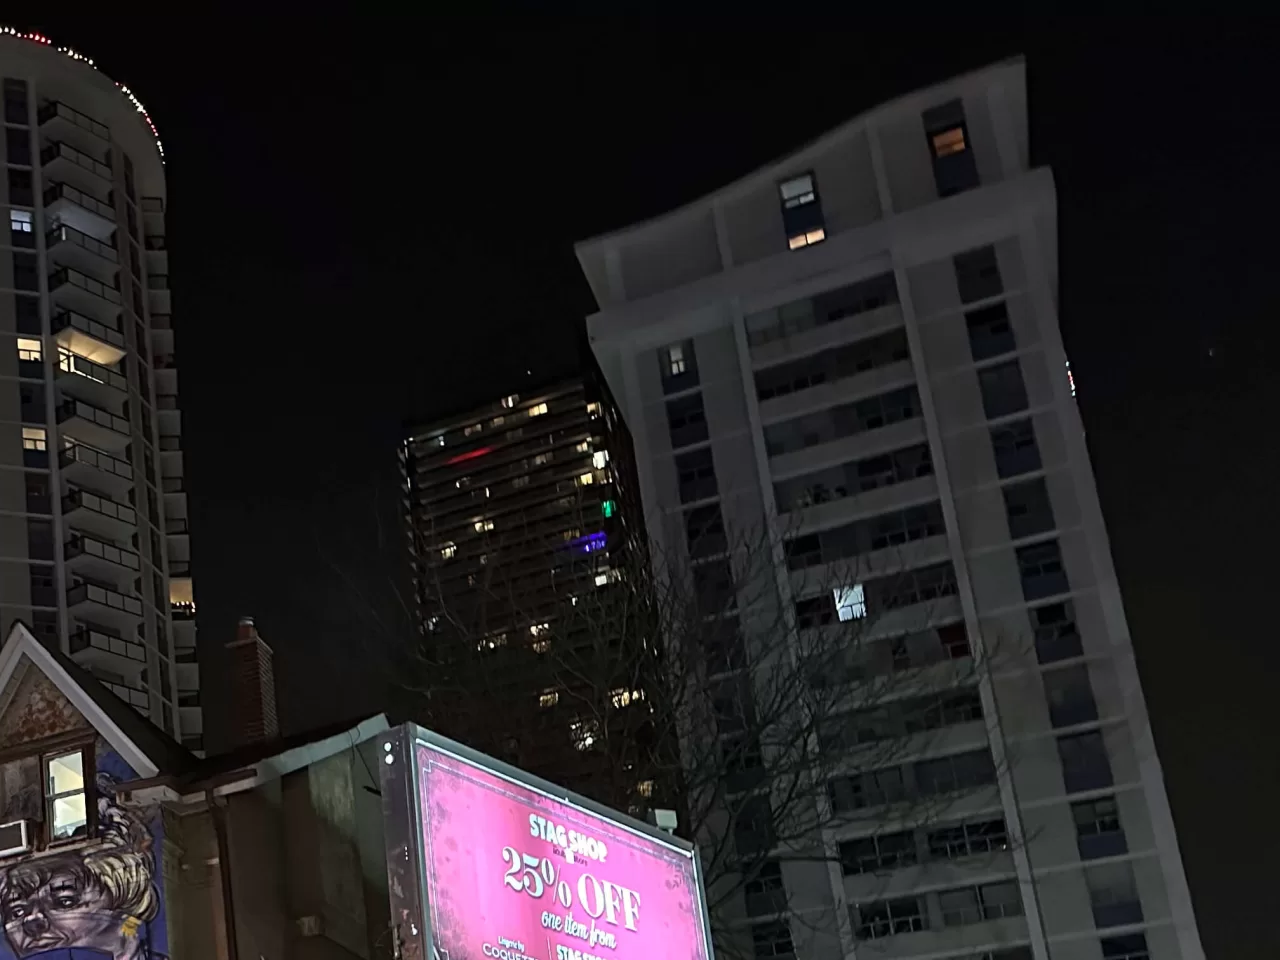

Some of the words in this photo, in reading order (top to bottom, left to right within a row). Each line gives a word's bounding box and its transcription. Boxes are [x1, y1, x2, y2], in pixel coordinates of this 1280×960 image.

[529, 813, 568, 848] STAG
[568, 829, 608, 863] SHOP
[502, 846, 572, 909] 25%
[576, 873, 641, 933] OFF
[541, 910, 562, 932] one
[564, 912, 589, 942] item
[589, 921, 617, 949] from
